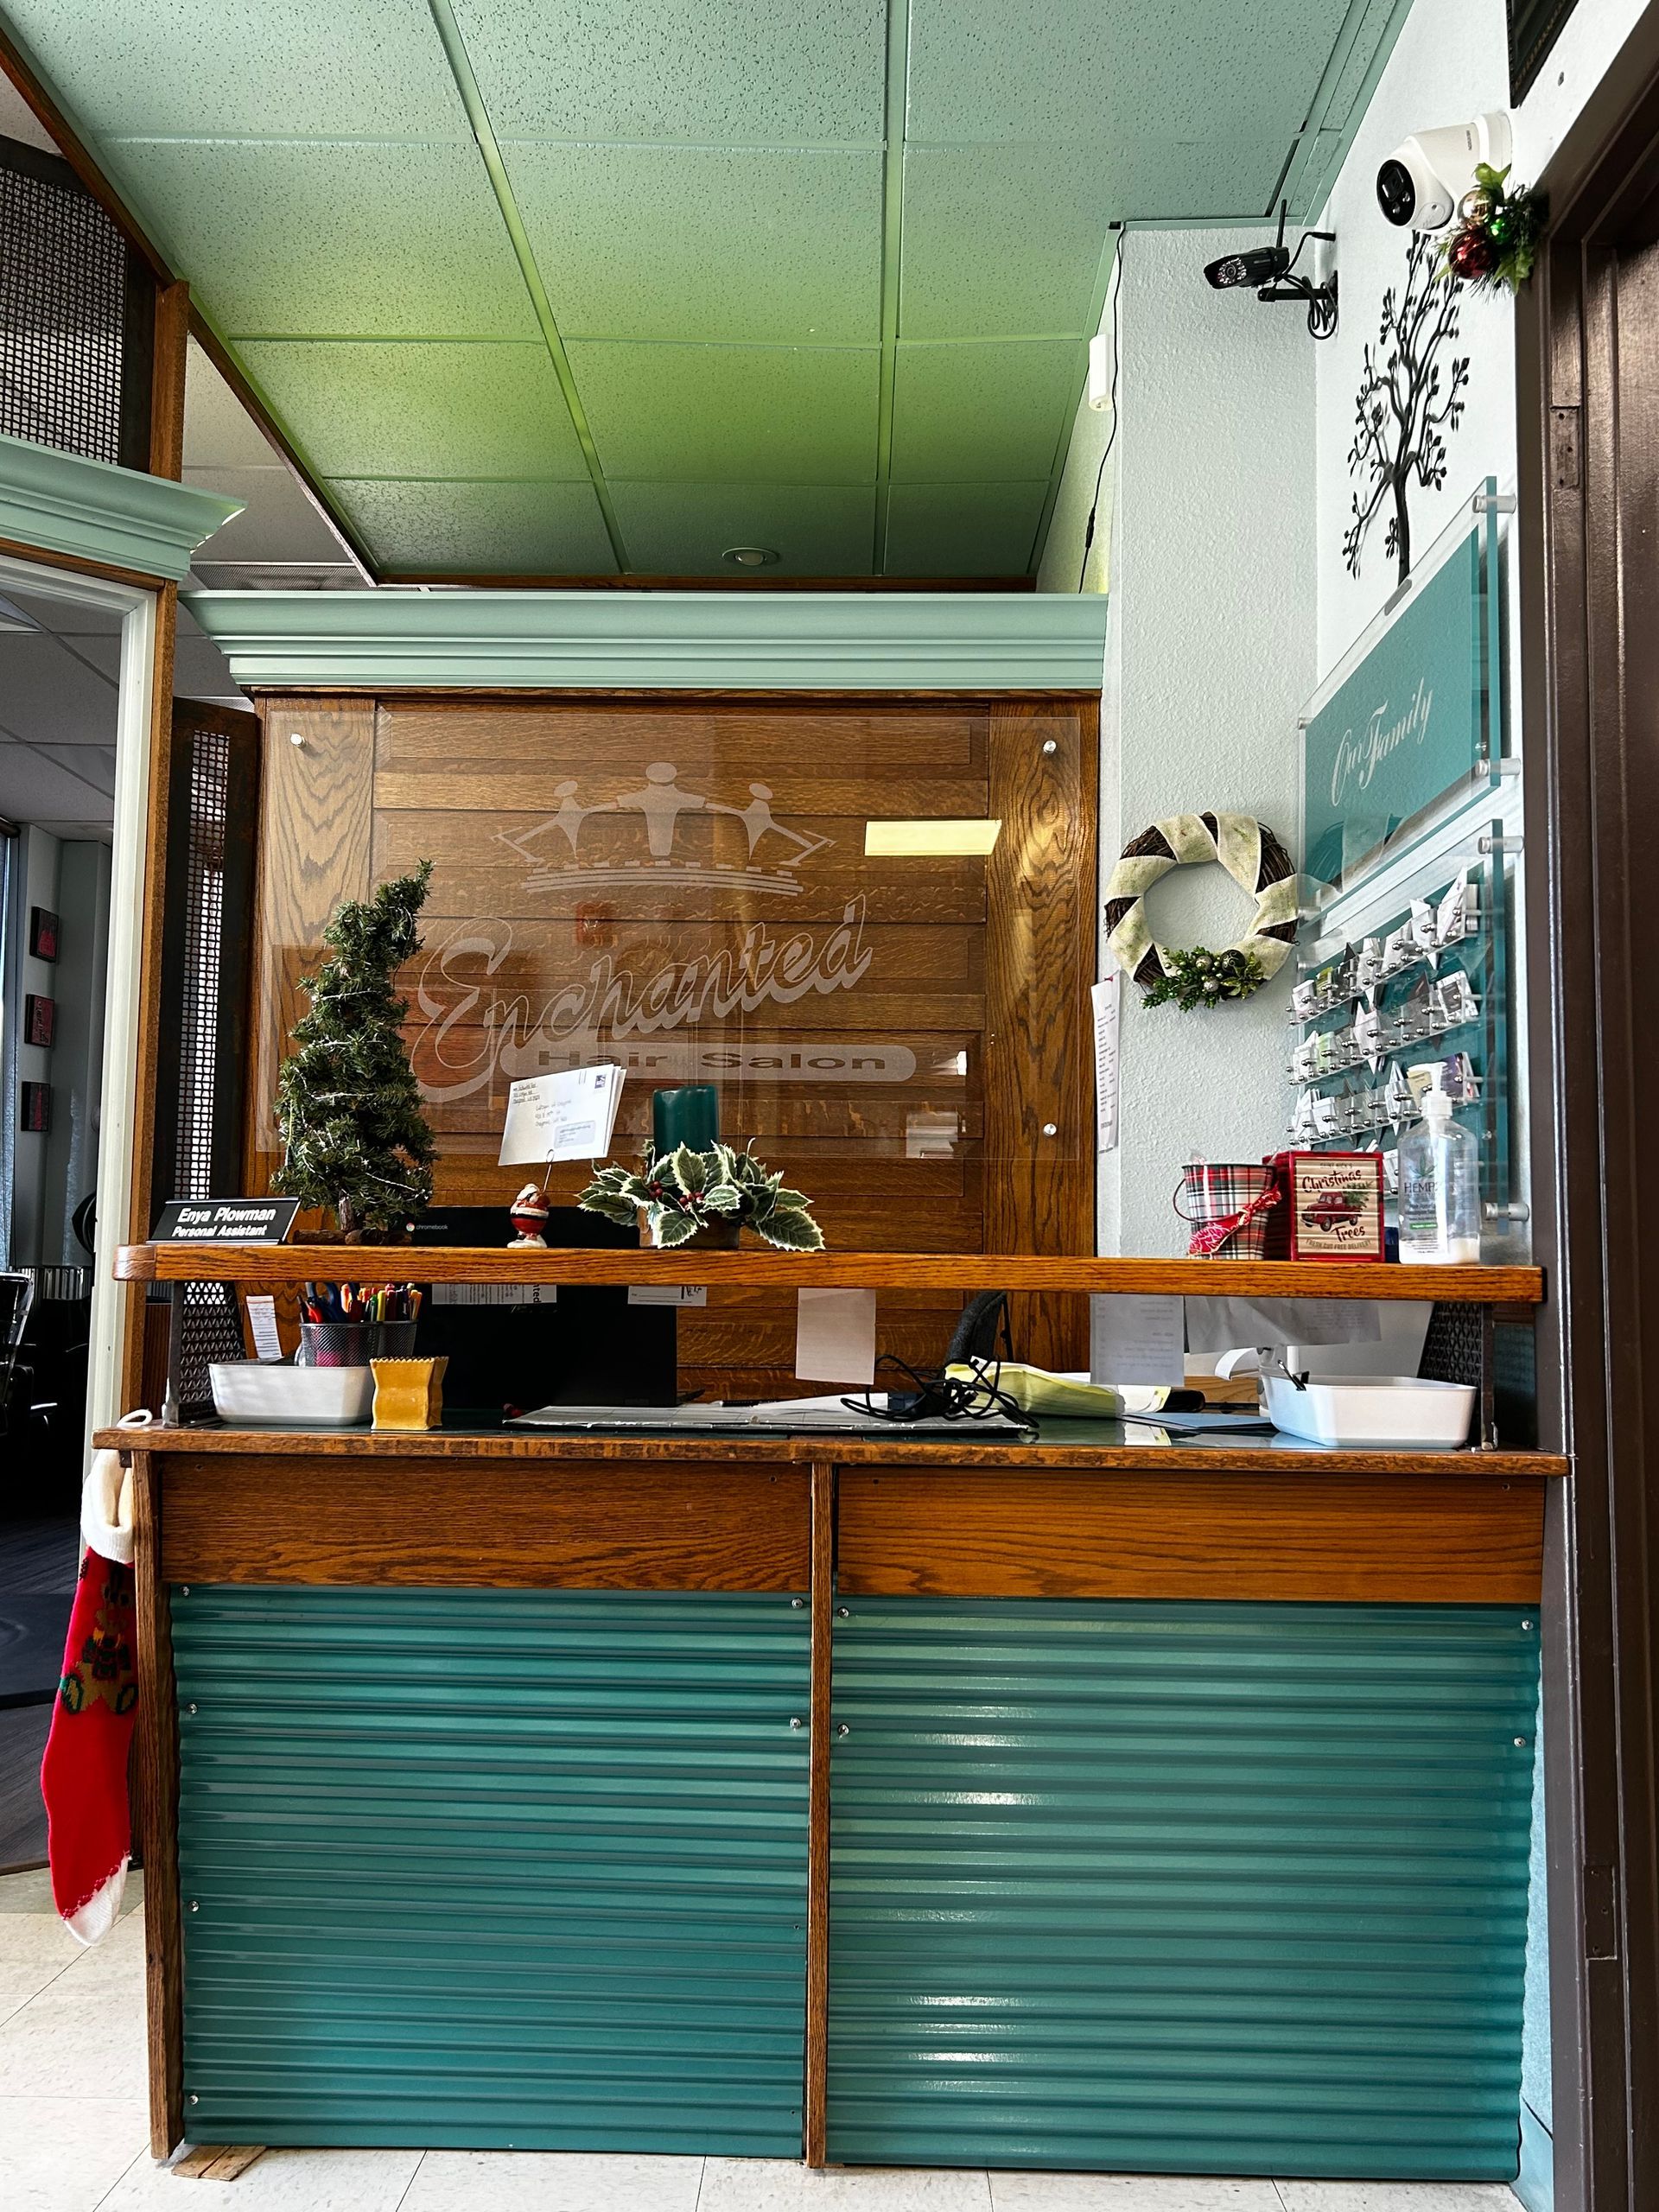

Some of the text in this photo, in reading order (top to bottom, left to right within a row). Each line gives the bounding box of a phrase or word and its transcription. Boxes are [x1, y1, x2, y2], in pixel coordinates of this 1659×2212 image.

[1359, 677, 1433, 790] Family
[410, 893, 874, 1103] Enchanted
[538, 1051, 886, 1070] Hair Salon
[1301, 1169, 1362, 1193] Christmas
[177, 1206, 276, 1224] Enya Plowman
[171, 1224, 268, 1237] Personal Assistant
[1331, 1225, 1366, 1243] Trees
